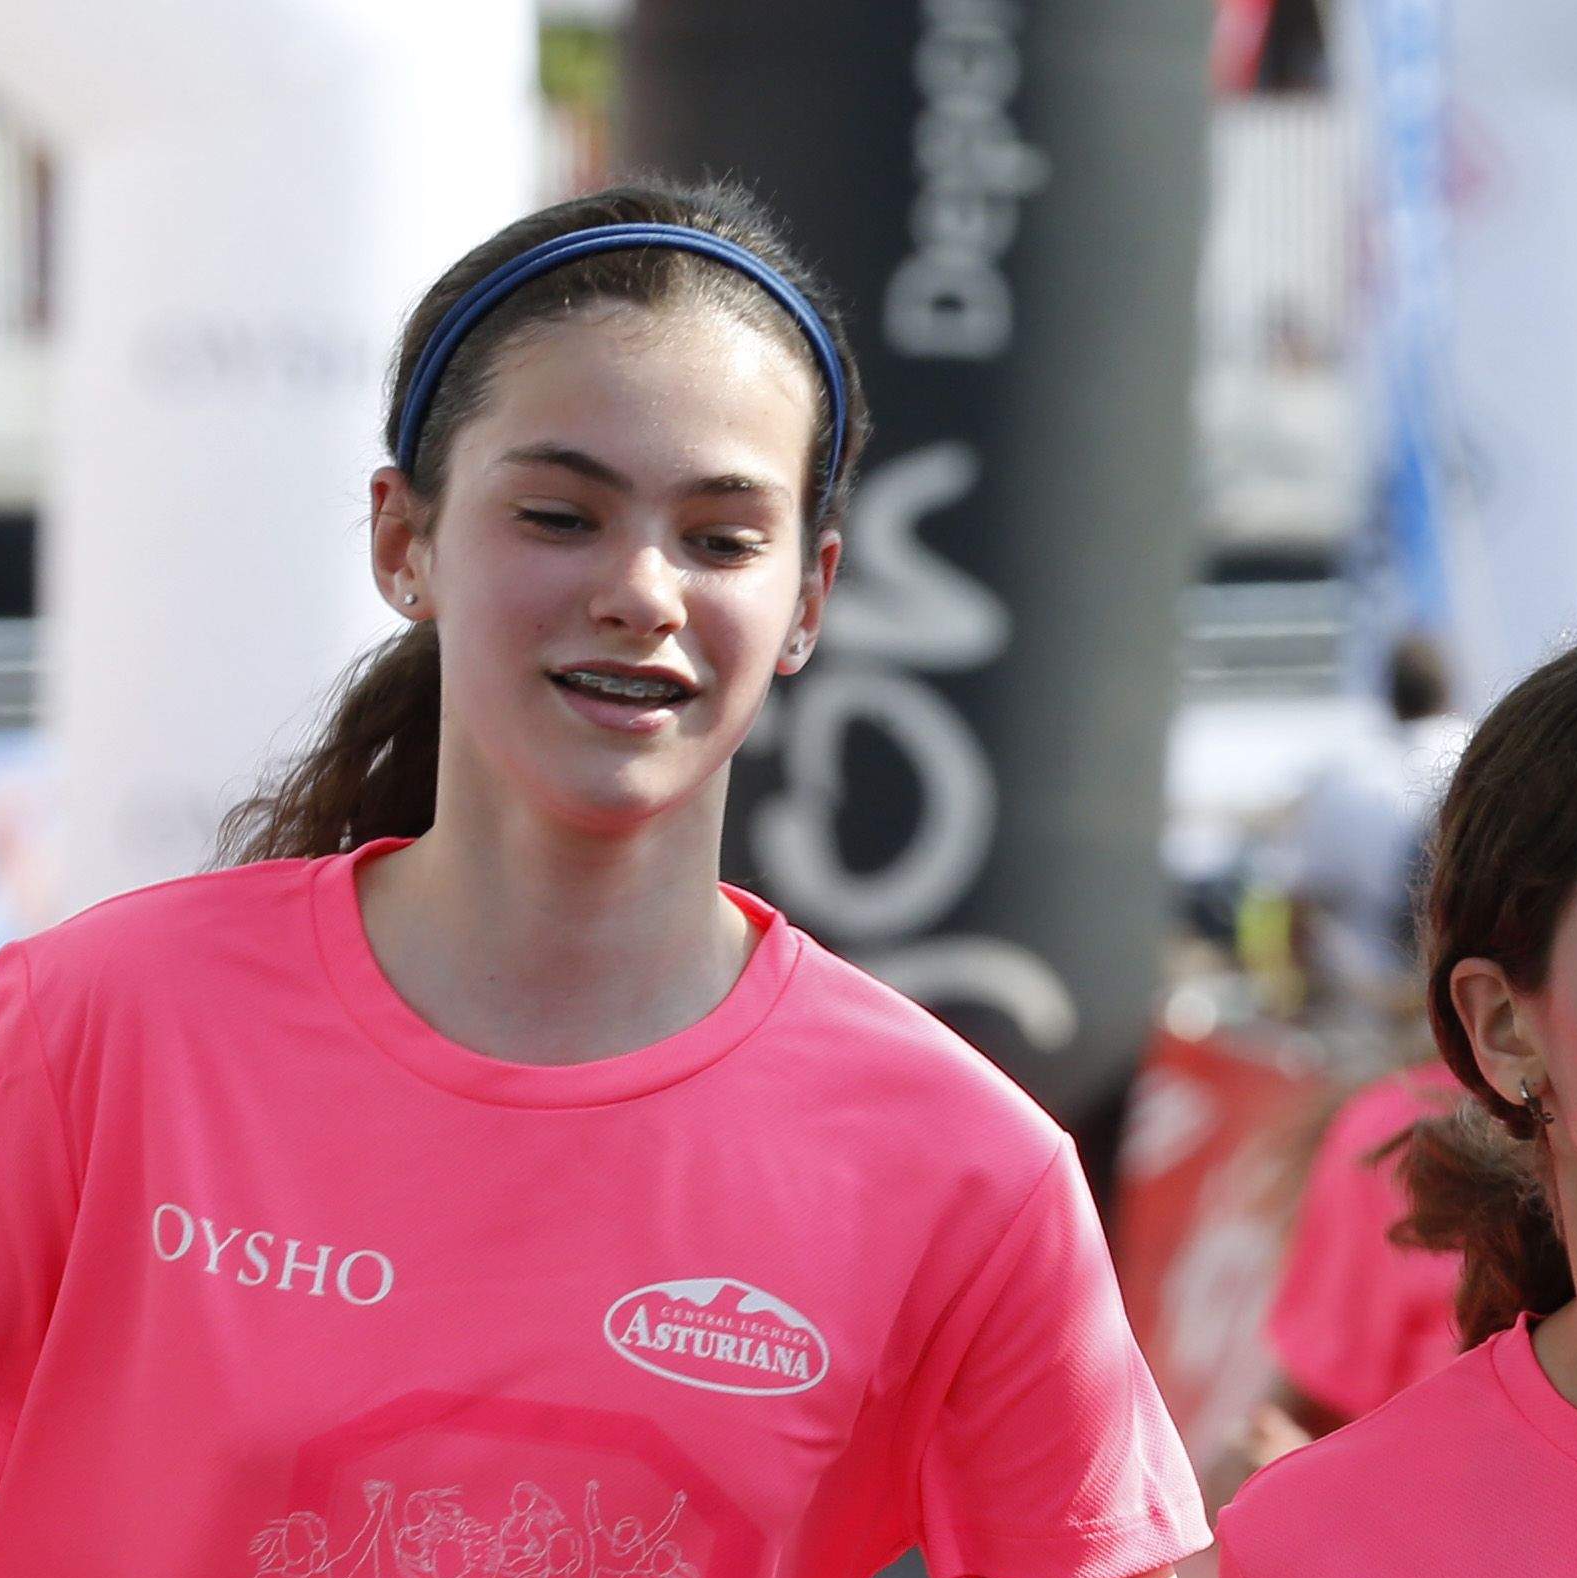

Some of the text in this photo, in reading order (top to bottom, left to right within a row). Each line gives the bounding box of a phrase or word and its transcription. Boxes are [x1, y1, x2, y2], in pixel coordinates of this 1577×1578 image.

[152, 1202, 395, 1305] OYSHO
[620, 1304, 811, 1380] ASTURIANA
[661, 1305, 810, 1347] CENTRAL LECHERA
